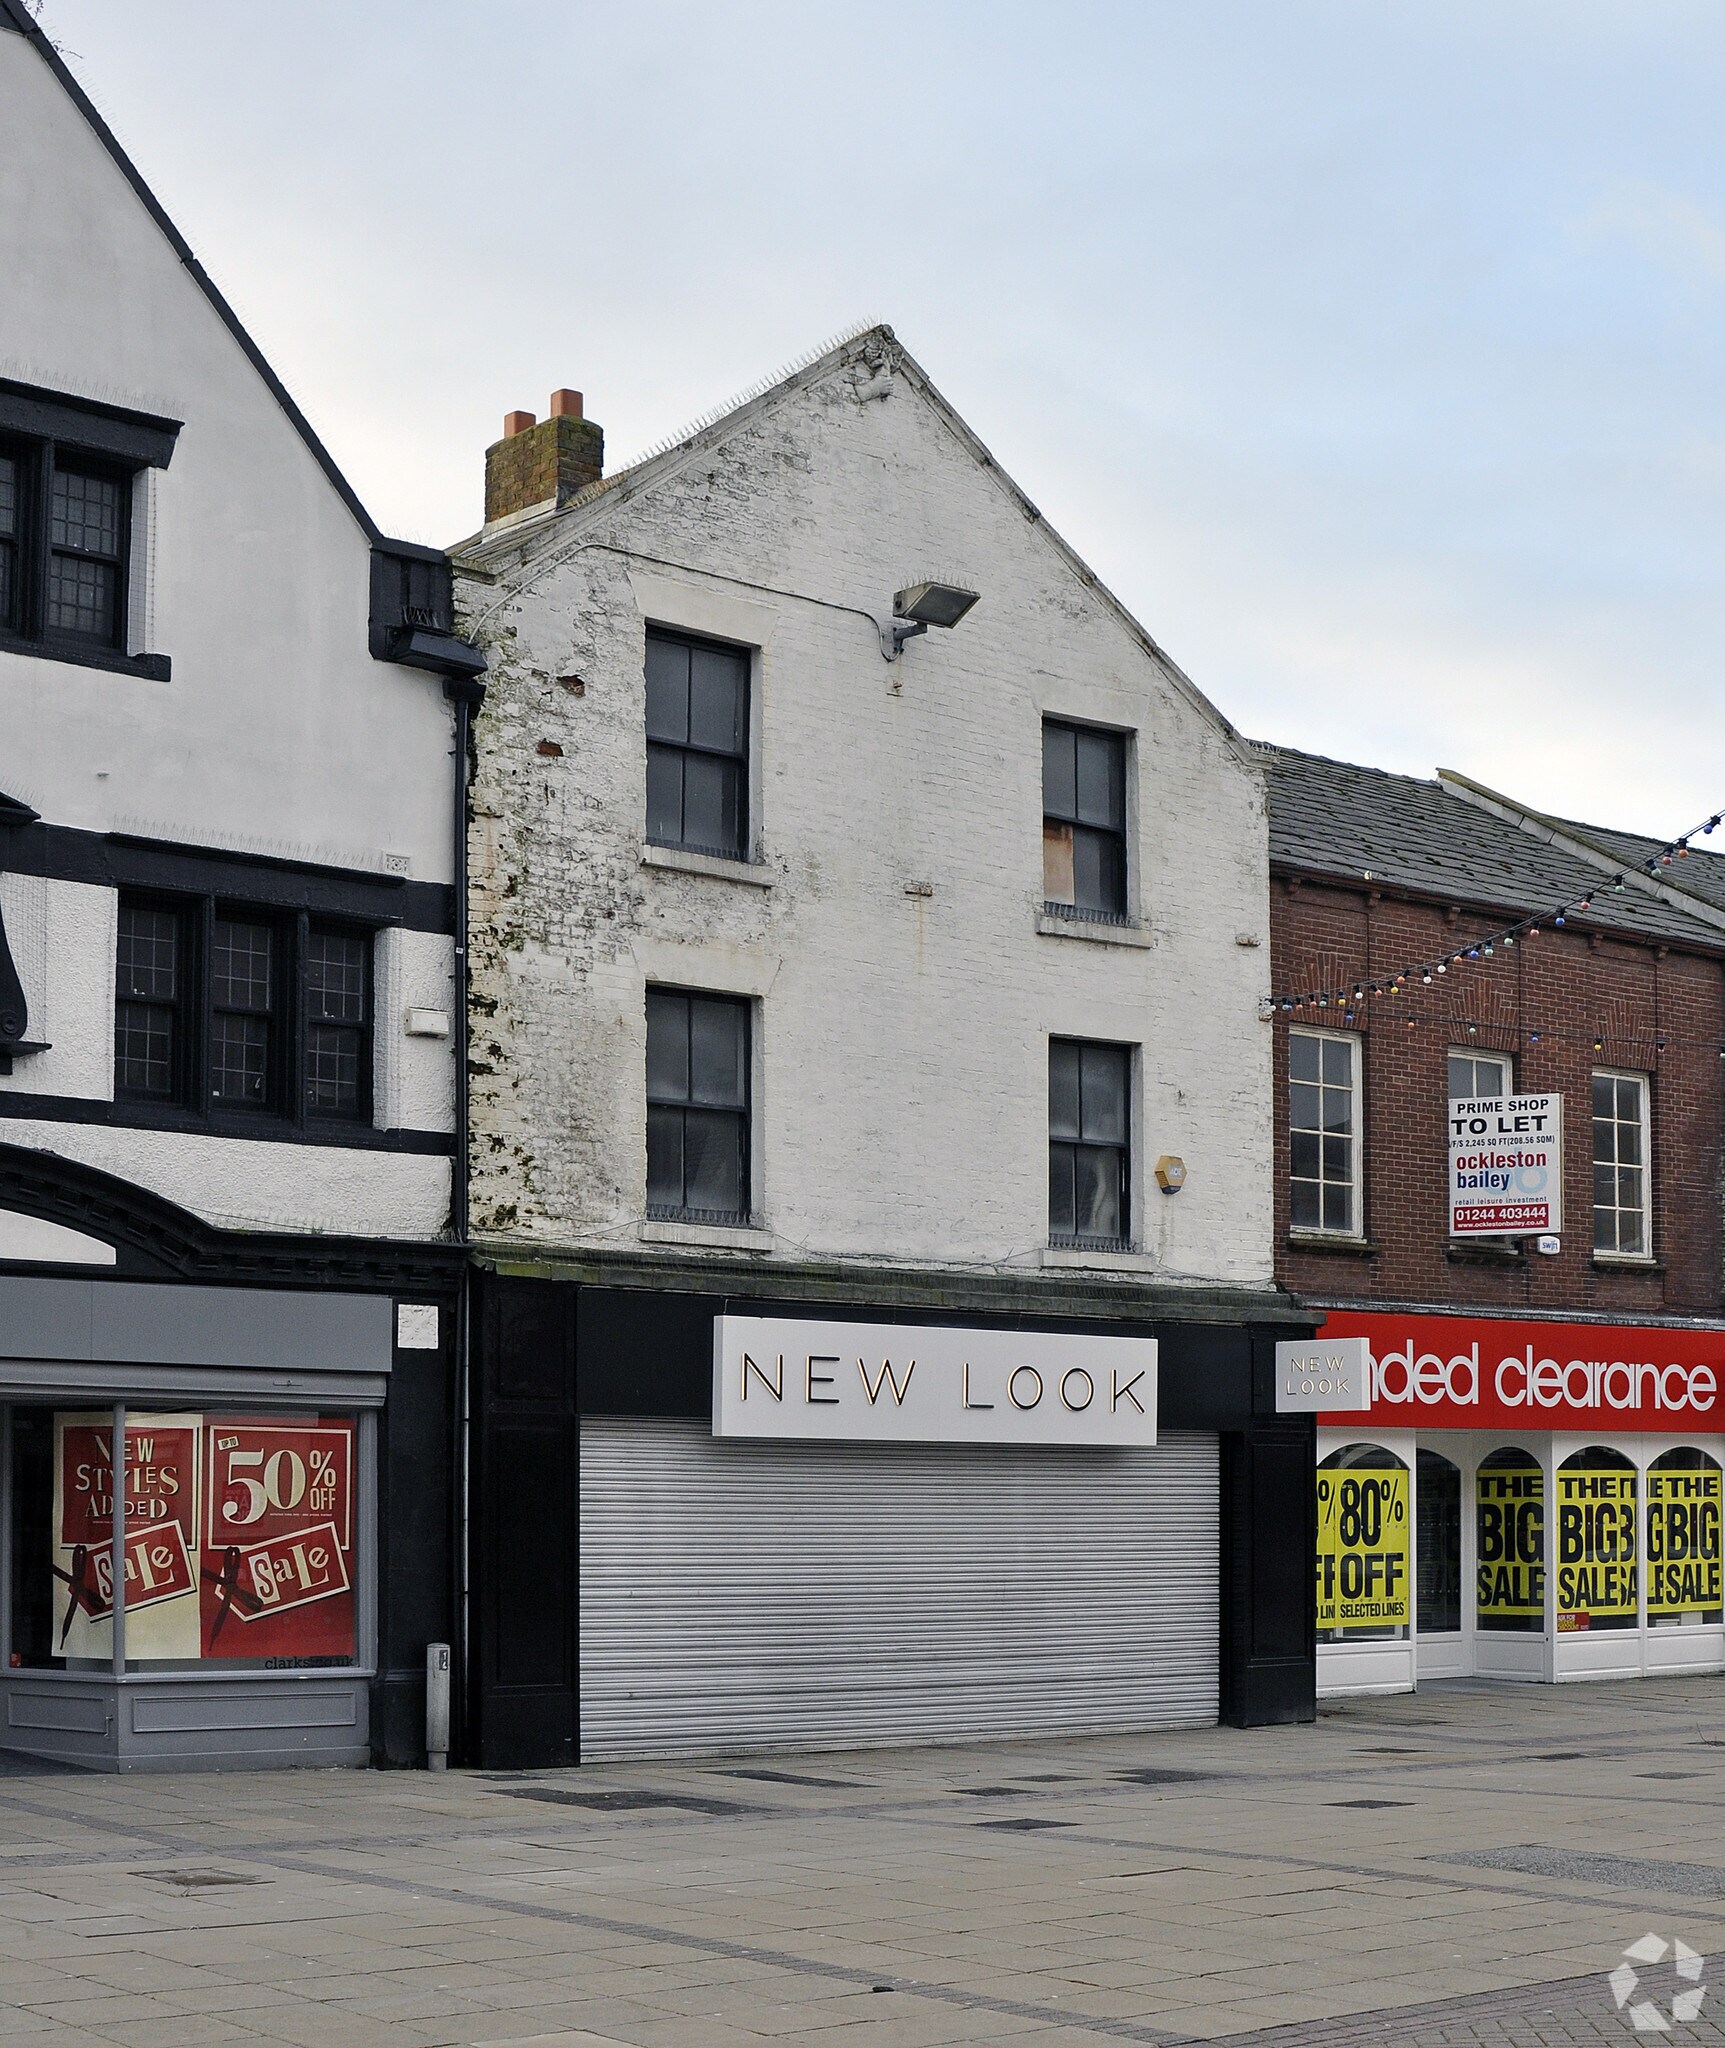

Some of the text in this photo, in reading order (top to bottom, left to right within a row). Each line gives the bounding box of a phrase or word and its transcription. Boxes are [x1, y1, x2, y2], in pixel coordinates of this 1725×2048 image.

[1457, 1099, 1549, 1114] PRIME SHOP
[1451, 1115, 1548, 1135] TO LET
[1487, 1138, 1497, 1146] SQ
[1456, 1151, 1547, 1170] ockleston
[1457, 1171, 1510, 1191] bailey
[1455, 1196, 1547, 1206] retail leisure investment
[1456, 1206, 1546, 1221] 01244 403444
[1457, 1219, 1545, 1228] www.ocklestonbailey.co.uk
[1290, 1355, 1344, 1373] NEW
[740, 1352, 1146, 1414] NEW LOOK
[1286, 1378, 1350, 1396] LOOK
[1494, 1344, 1717, 1412] clearance
[94, 1434, 154, 1464] NEW
[1478, 1476, 1544, 1498] THE
[1559, 1477, 1616, 1499] THE
[1666, 1476, 1719, 1498] THE
[84, 1494, 168, 1519] ADDED
[310, 1488, 336, 1511] OFF
[1340, 1478, 1404, 1547] 80%
[1477, 1502, 1544, 1564] BIG
[1560, 1502, 1617, 1564] BIG
[1667, 1501, 1720, 1561] BIG
[1340, 1553, 1404, 1600] OFF
[1477, 1565, 1544, 1608] SALE
[1666, 1563, 1720, 1605] SALE
[1559, 1566, 1618, 1610] SALE
[1340, 1602, 1405, 1619] SELECTED LINES
